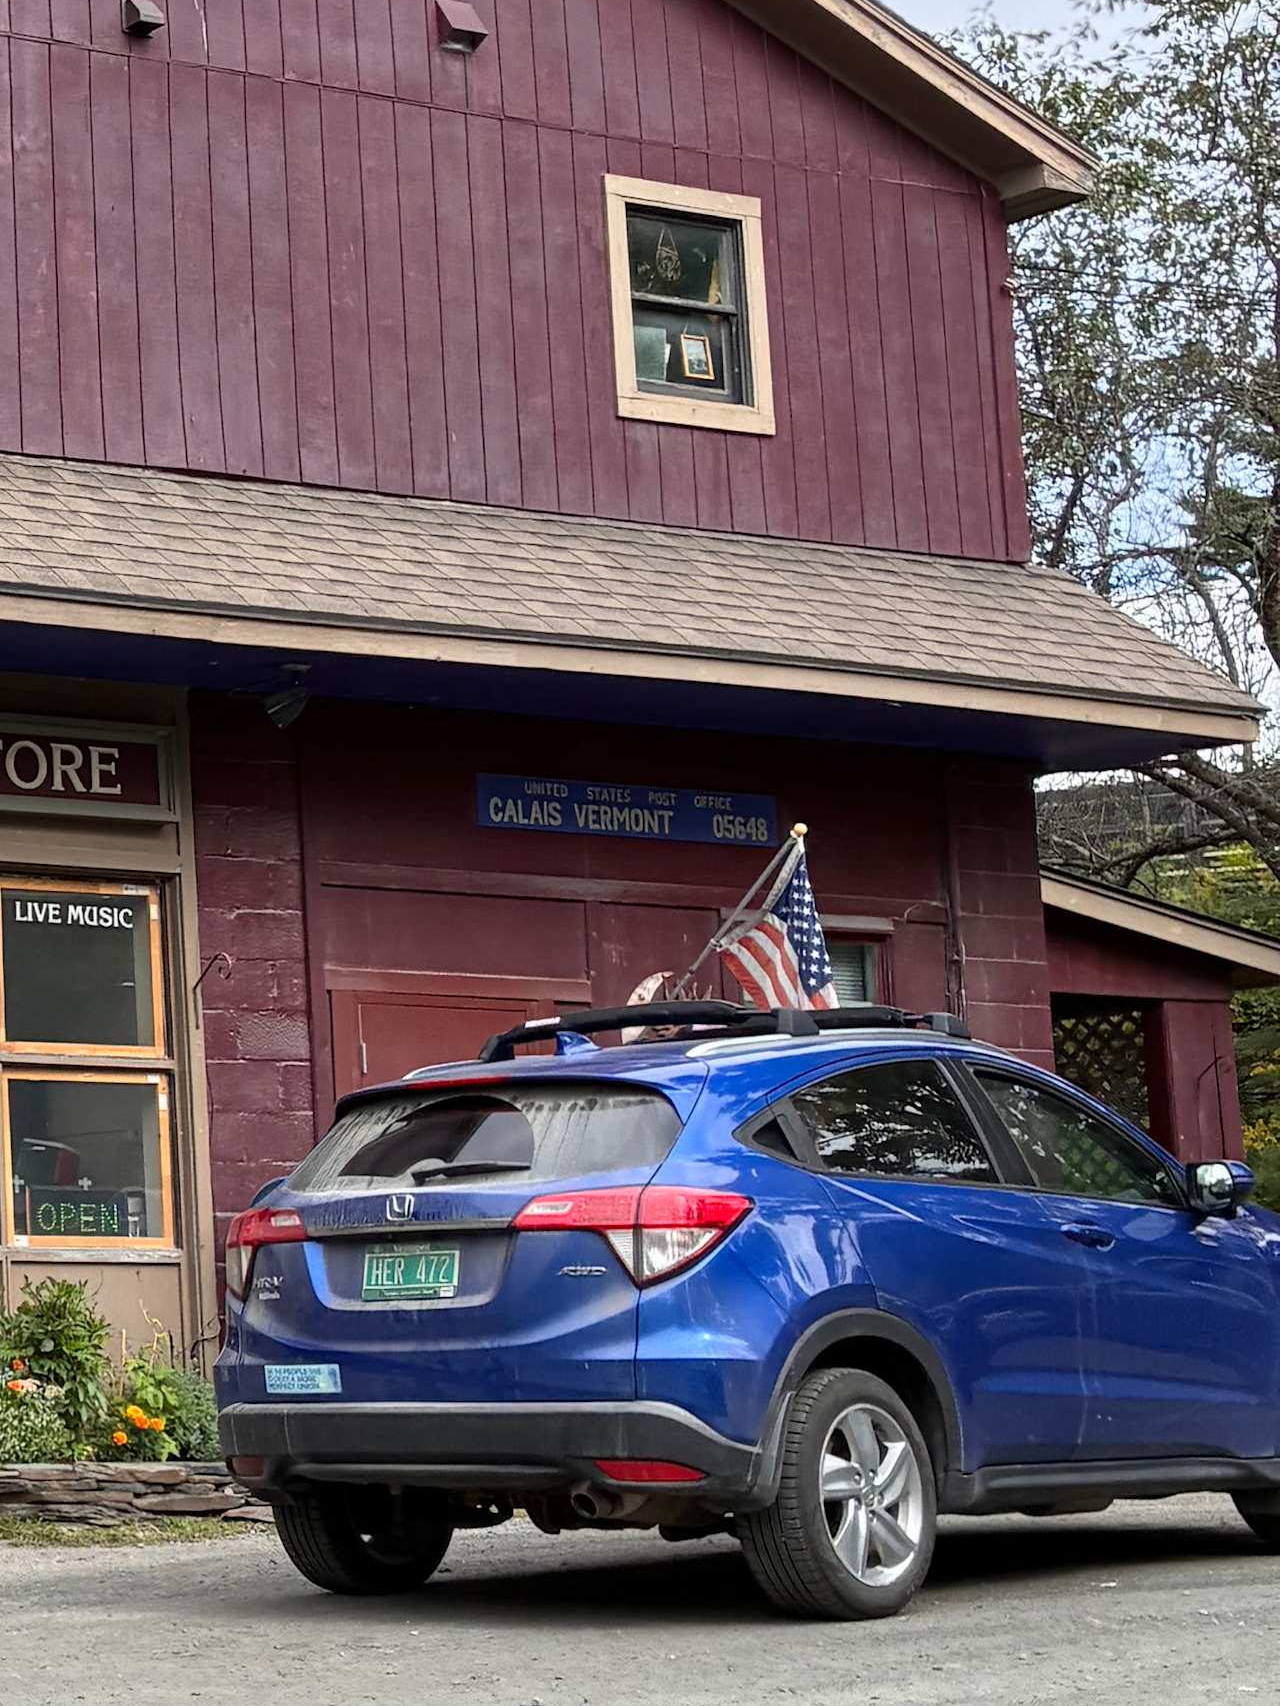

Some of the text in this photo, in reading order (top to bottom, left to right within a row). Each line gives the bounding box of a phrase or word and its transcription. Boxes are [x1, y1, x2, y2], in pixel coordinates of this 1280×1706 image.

[524, 781, 733, 811] UNITED STATES POST OFFICE
[488, 796, 768, 842] CALAIS VERMONT 05648
[15, 901, 62, 924] LIVE
[67, 905, 134, 929] MUSIC
[36, 1202, 119, 1232] OPEN
[371, 1255, 450, 1285] HER 472
